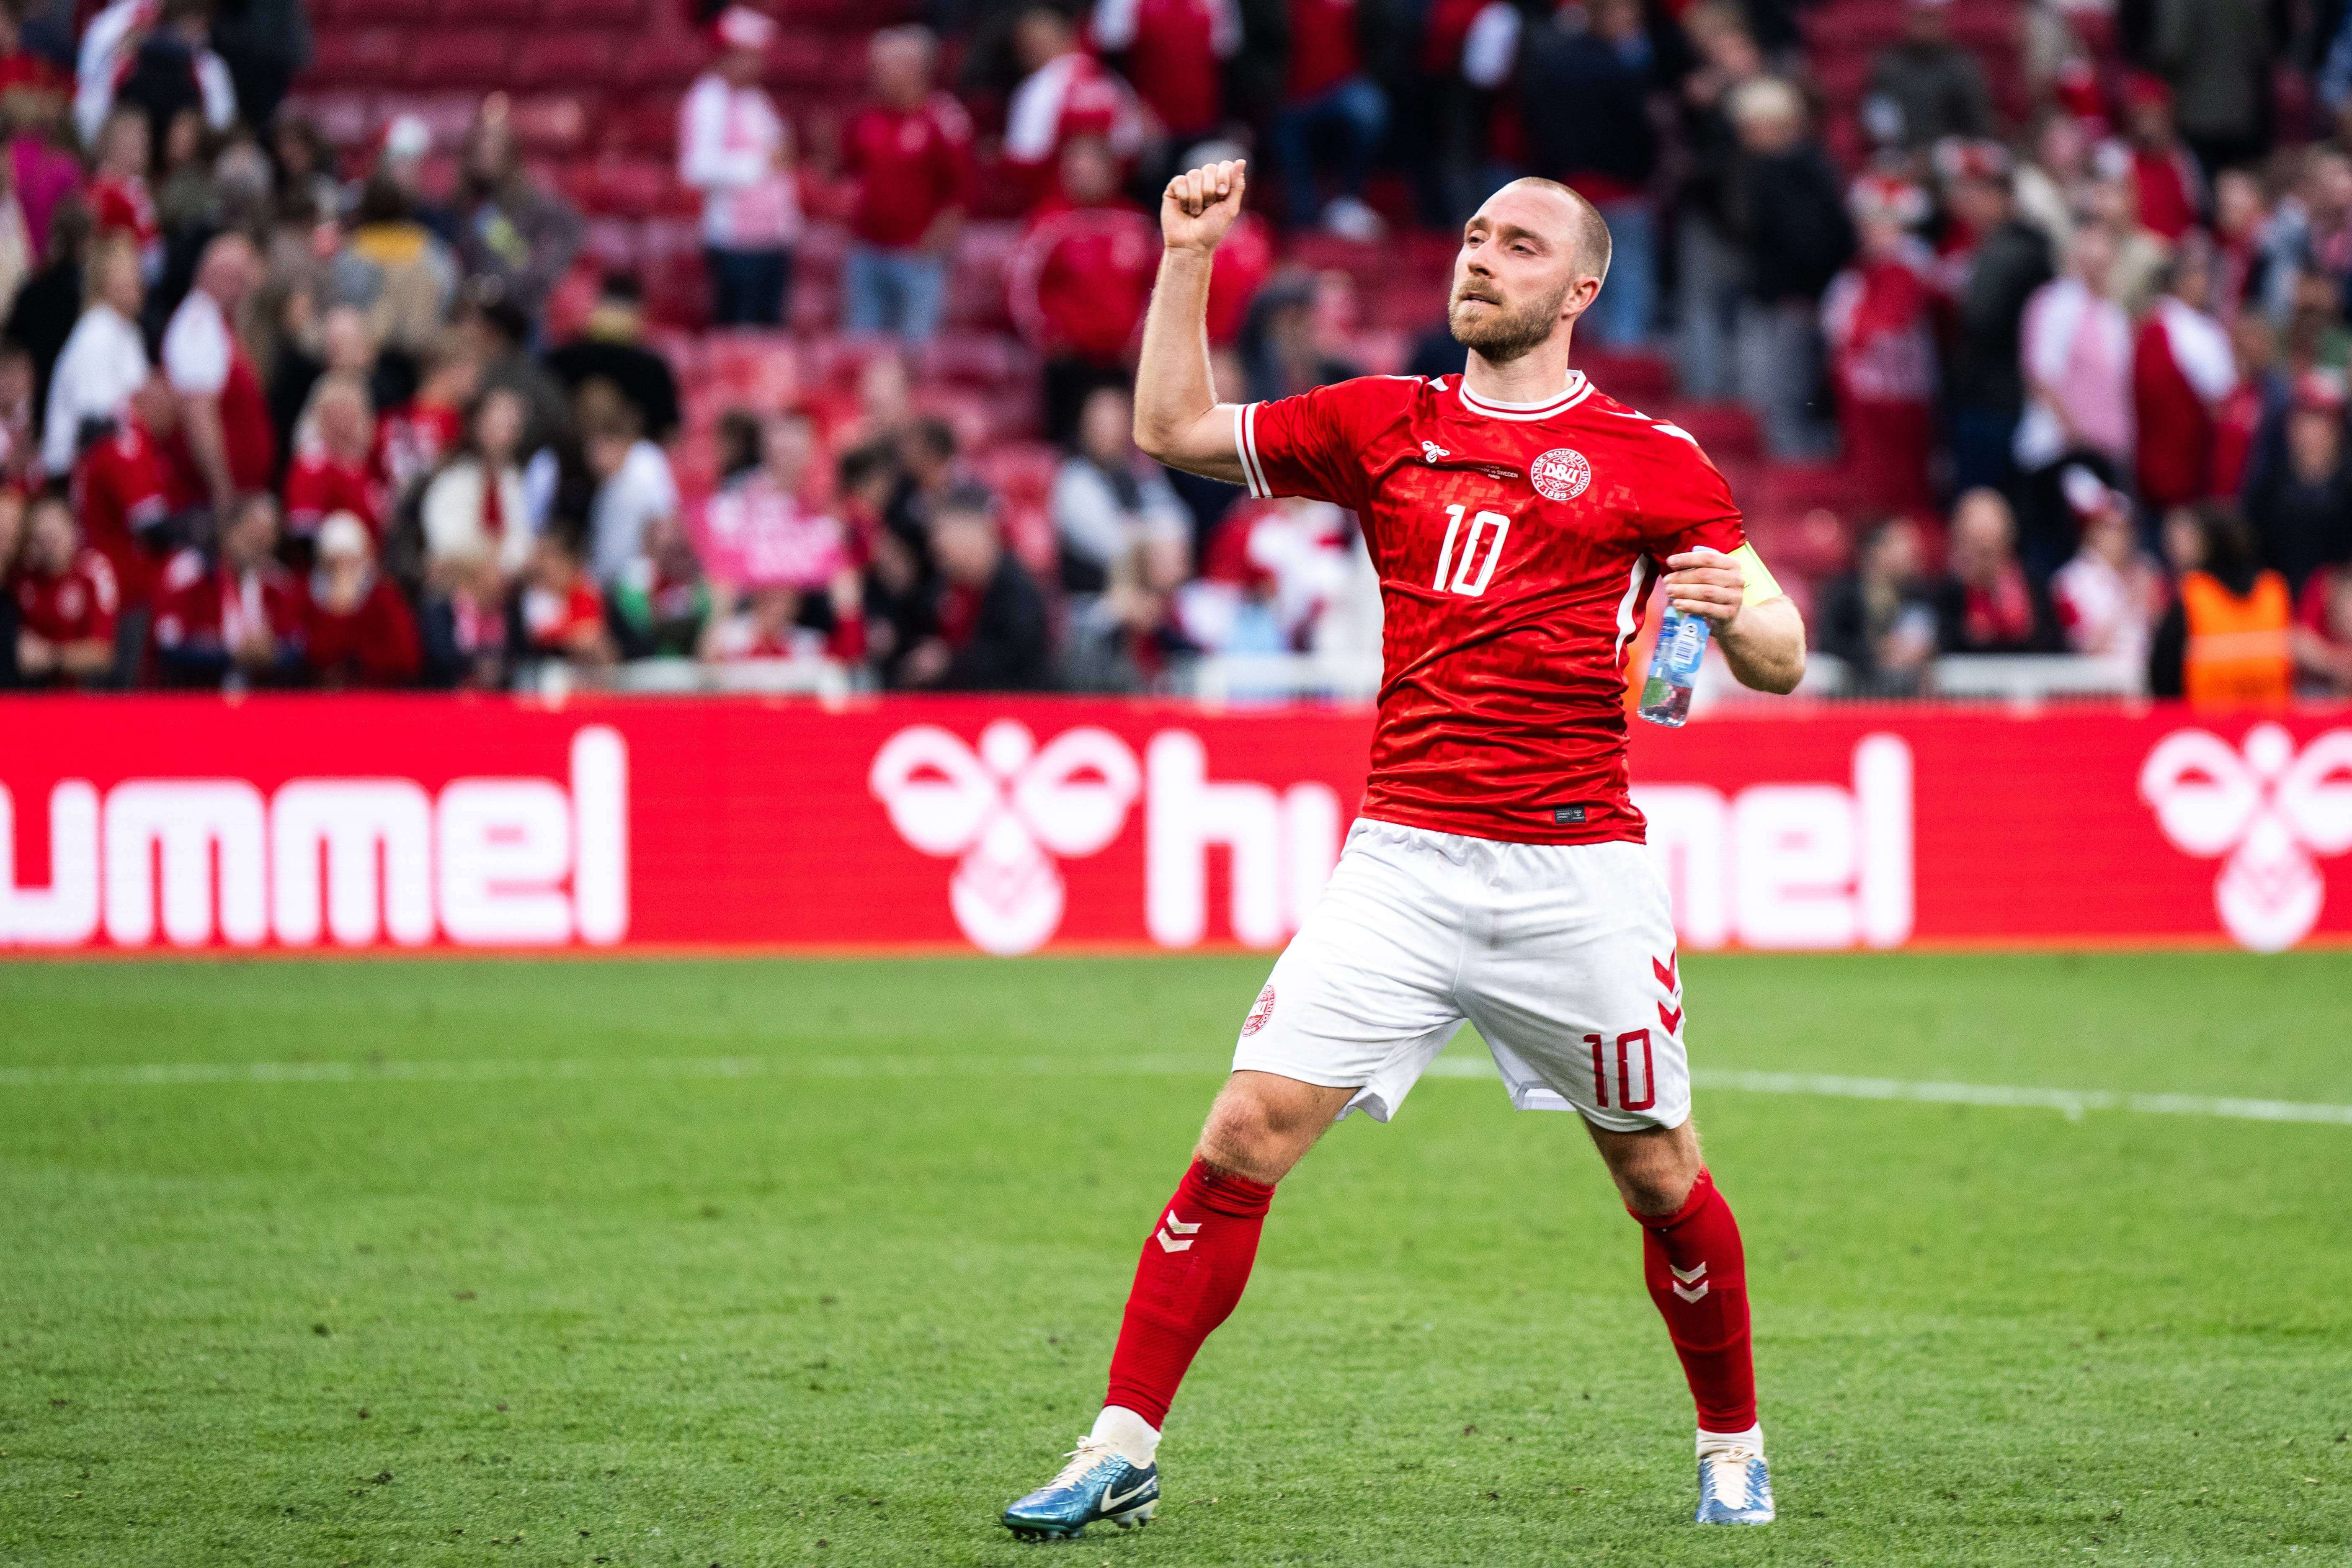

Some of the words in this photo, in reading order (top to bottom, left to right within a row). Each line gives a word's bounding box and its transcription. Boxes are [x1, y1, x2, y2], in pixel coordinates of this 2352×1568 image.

[1533, 456, 1547, 488] DANSK
[1570, 470, 1589, 496] UNION
[1542, 462, 1580, 484] DBU
[1542, 487, 1567, 499] 1889
[1432, 504, 1511, 597] 10
[1583, 1028, 1656, 1112] 10
